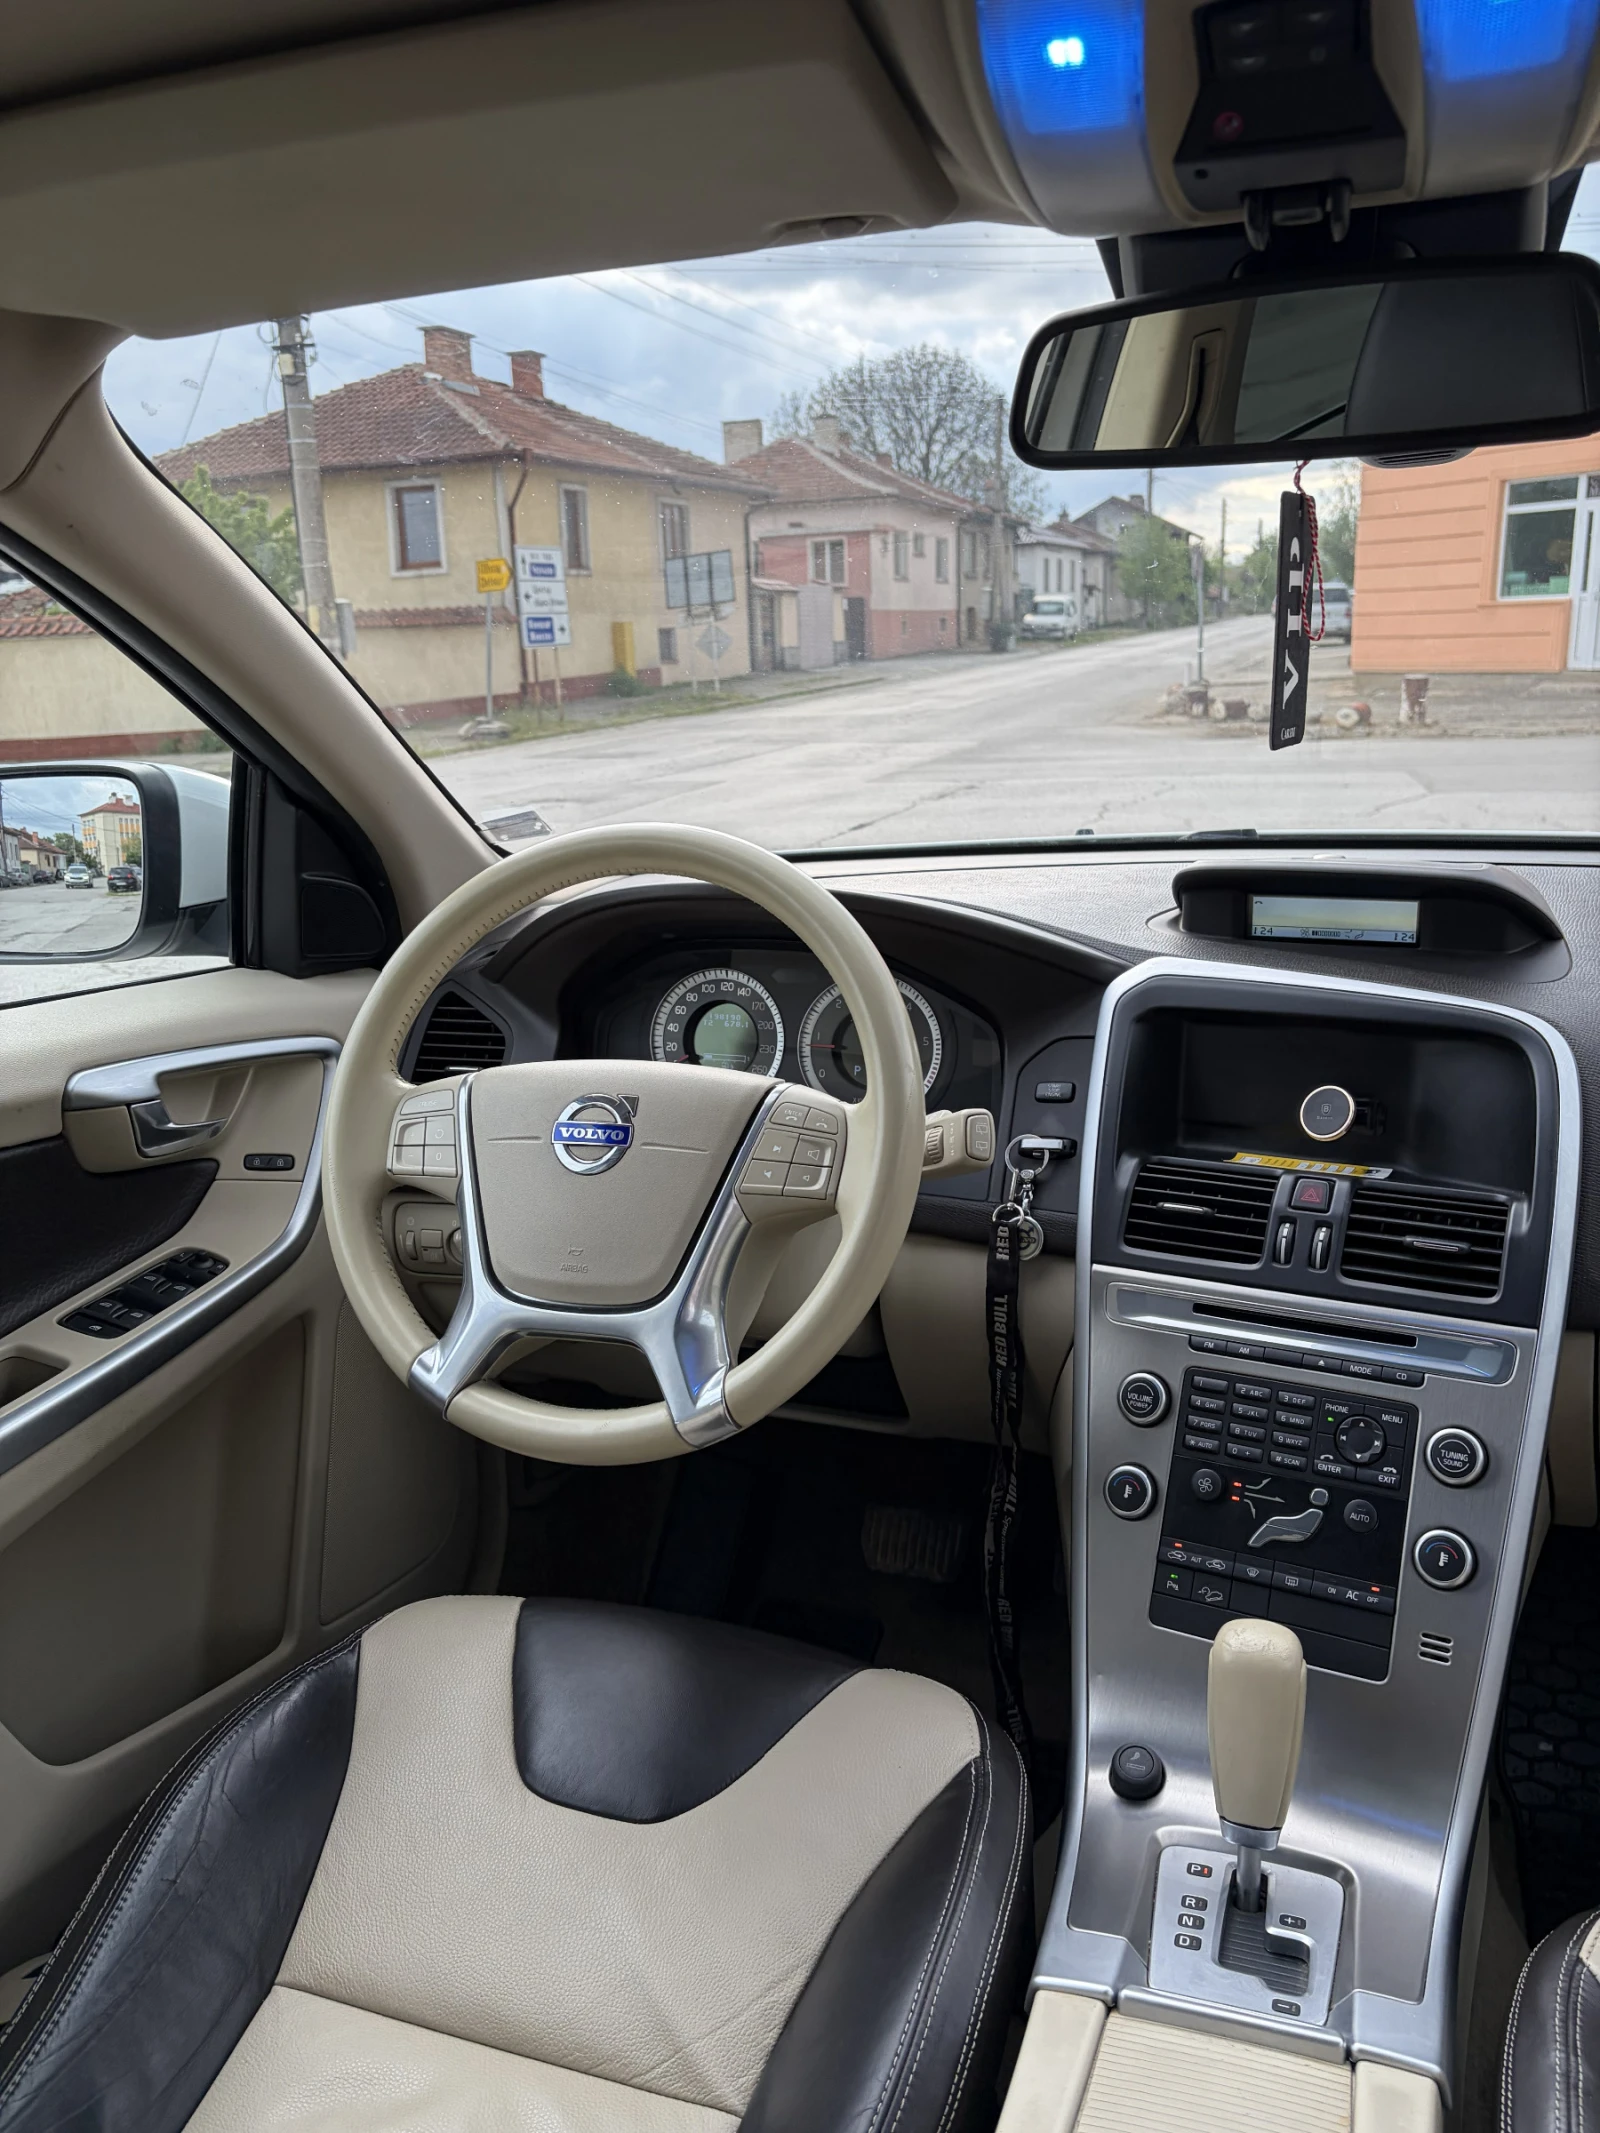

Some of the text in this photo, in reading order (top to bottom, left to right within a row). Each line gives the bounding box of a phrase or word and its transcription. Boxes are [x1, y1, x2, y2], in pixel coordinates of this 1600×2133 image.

[1283, 536, 1304, 709] VIP
[701, 984, 716, 993] 100
[720, 982, 734, 991] 120
[737, 987, 751, 997] 140
[686, 993, 698, 1002] 80
[674, 1006, 687, 1015] 60
[751, 1001, 765, 1011] 170
[667, 1023, 679, 1032] 40
[757, 1021, 774, 1030] 200
[666, 1042, 677, 1051] 20
[759, 1045, 775, 1054] 230
[854, 1065, 862, 1076] P
[559, 1127, 625, 1141] VOLVO
[996, 1226, 1010, 1261] RED
[560, 1263, 588, 1273] AIRBAG
[993, 1294, 1008, 1367] RED BULL
[1350, 1365, 1372, 1375] MODE
[1396, 1372, 1407, 1380] CD
[1127, 1391, 1153, 1403] VOLUME
[1325, 1403, 1349, 1414] PHONE
[1382, 1414, 1403, 1424] MENU
[1197, 1441, 1213, 1449] AUTO
[1440, 1449, 1469, 1461] TUNING
[1284, 1458, 1300, 1466] SCAN
[1443, 1459, 1463, 1468] SOUND
[1318, 1464, 1342, 1474] ENTER
[1378, 1475, 1396, 1484] EXIT
[1349, 1512, 1370, 1523] AUTO
[1327, 1587, 1337, 1595] ON
[1345, 1590, 1359, 1601] AC
[1366, 1596, 1378, 1604] OFF
[1190, 1865, 1201, 1873] P
[1185, 1898, 1196, 1908] R
[1182, 1916, 1193, 1926] N
[1179, 1936, 1190, 1946] D
